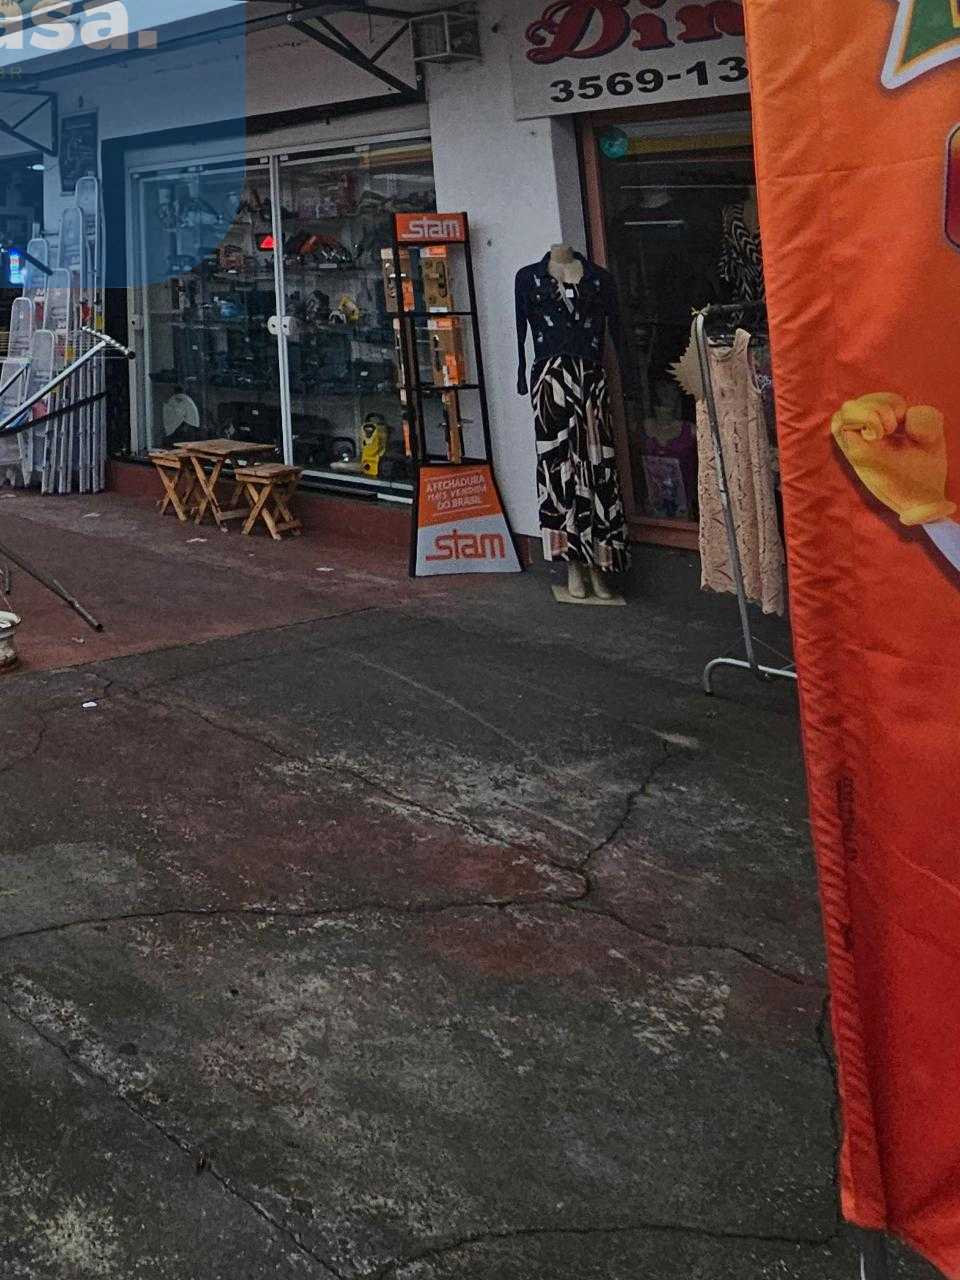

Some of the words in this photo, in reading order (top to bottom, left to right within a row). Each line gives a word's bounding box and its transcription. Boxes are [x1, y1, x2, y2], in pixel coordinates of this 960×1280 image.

[550, 56, 749, 103] 3569-13
[401, 216, 461, 239] stam
[425, 529, 506, 561] stam
